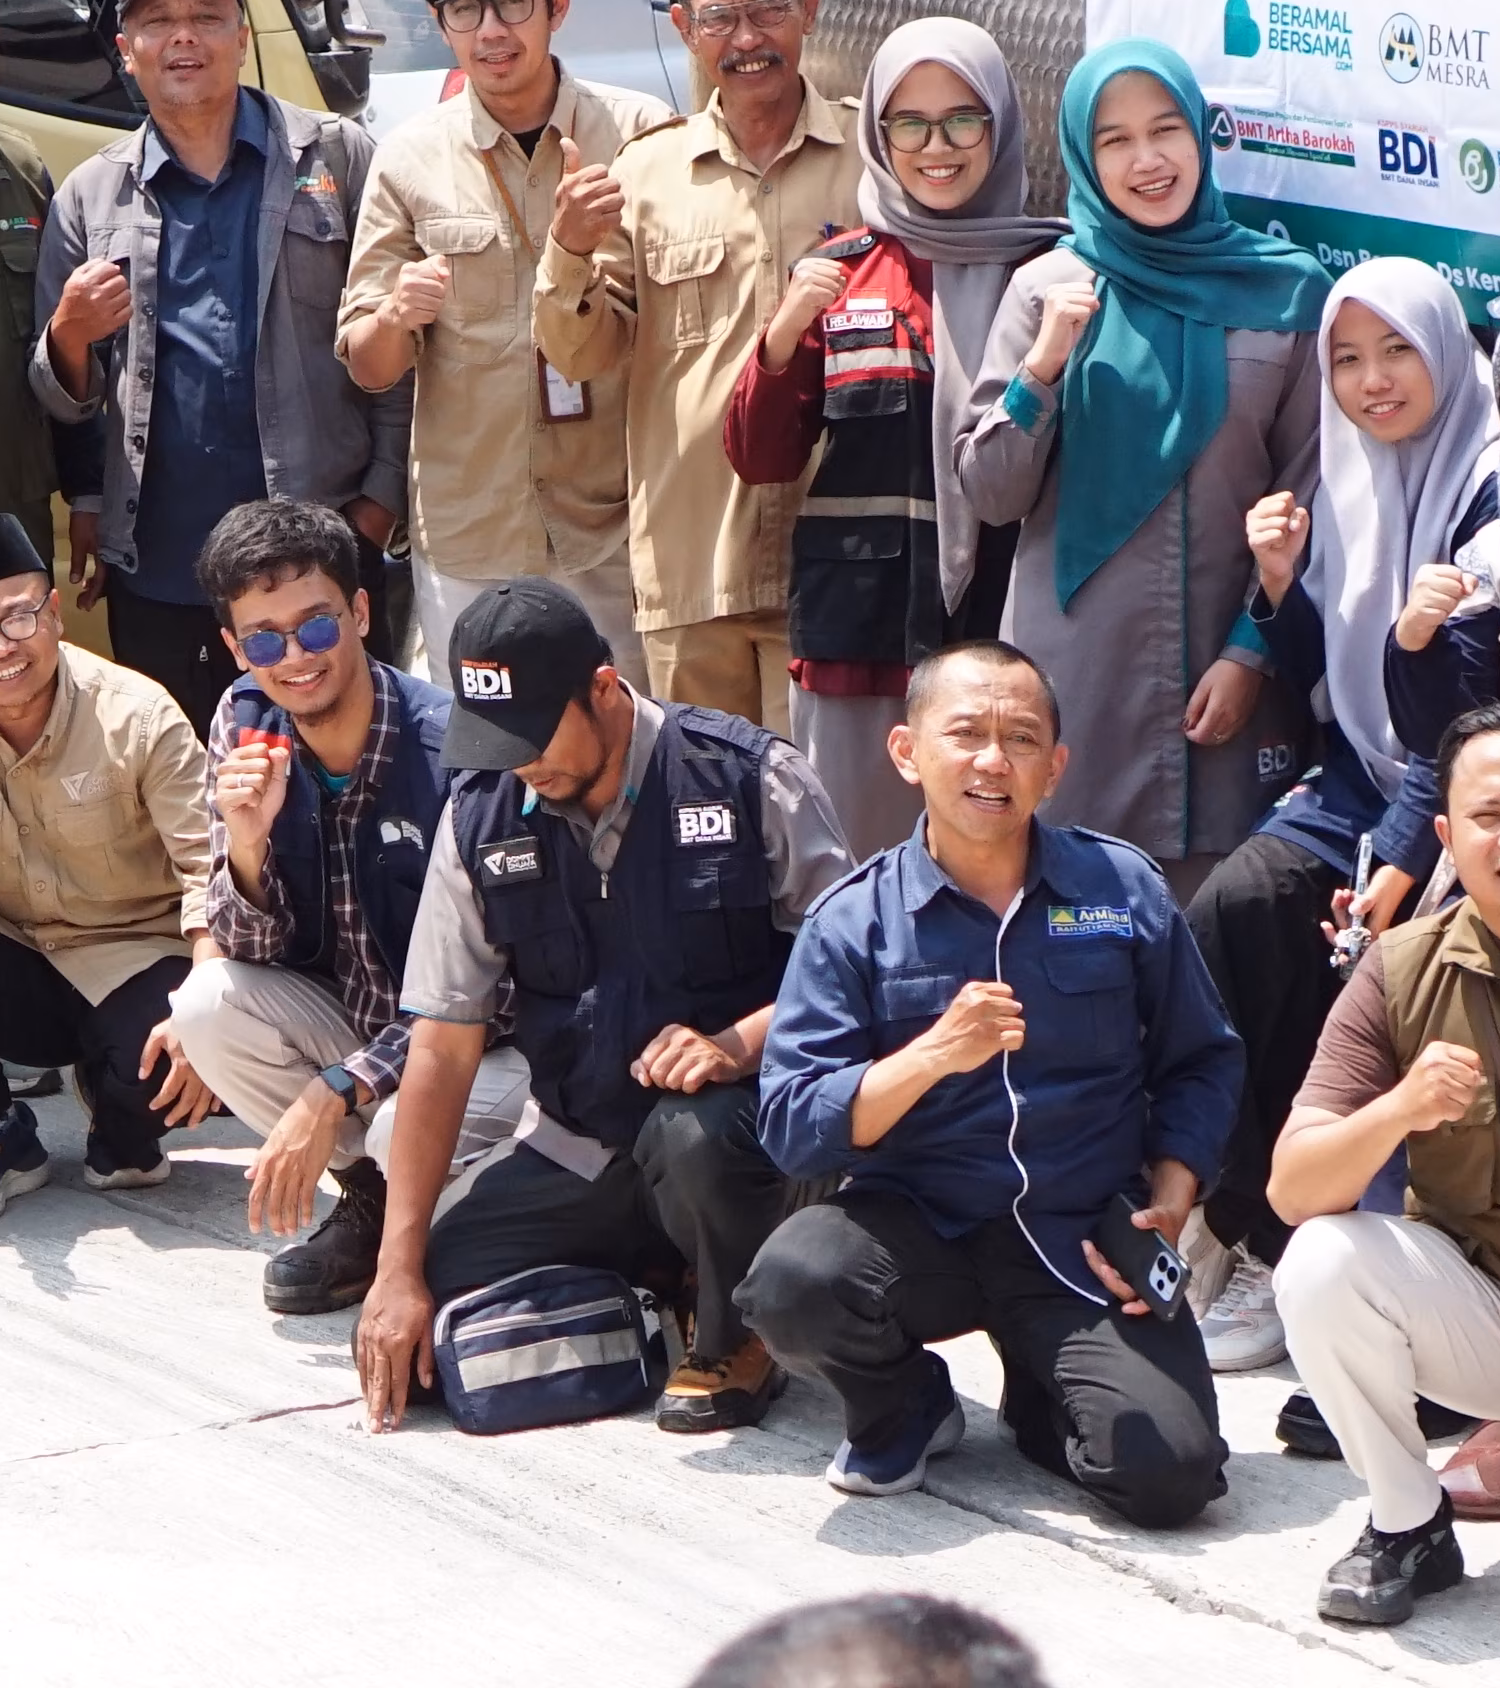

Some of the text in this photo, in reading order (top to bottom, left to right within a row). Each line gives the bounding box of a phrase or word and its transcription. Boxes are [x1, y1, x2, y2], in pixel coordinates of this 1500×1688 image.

[1268, 1, 1352, 35] BERAMAL
[1267, 28, 1353, 61] BERSAMA
[1427, 23, 1491, 63] BMT
[1426, 61, 1491, 90] MESRA
[1236, 120, 1264, 140] BMT
[1267, 124, 1300, 146] Artha
[1303, 129, 1355, 154] Barokah
[1378, 128, 1439, 179] BDI
[828, 313, 888, 328] RELAWAN
[461, 665, 512, 695] BDI
[678, 809, 733, 837] BDI
[1078, 908, 1128, 923] ArMina
